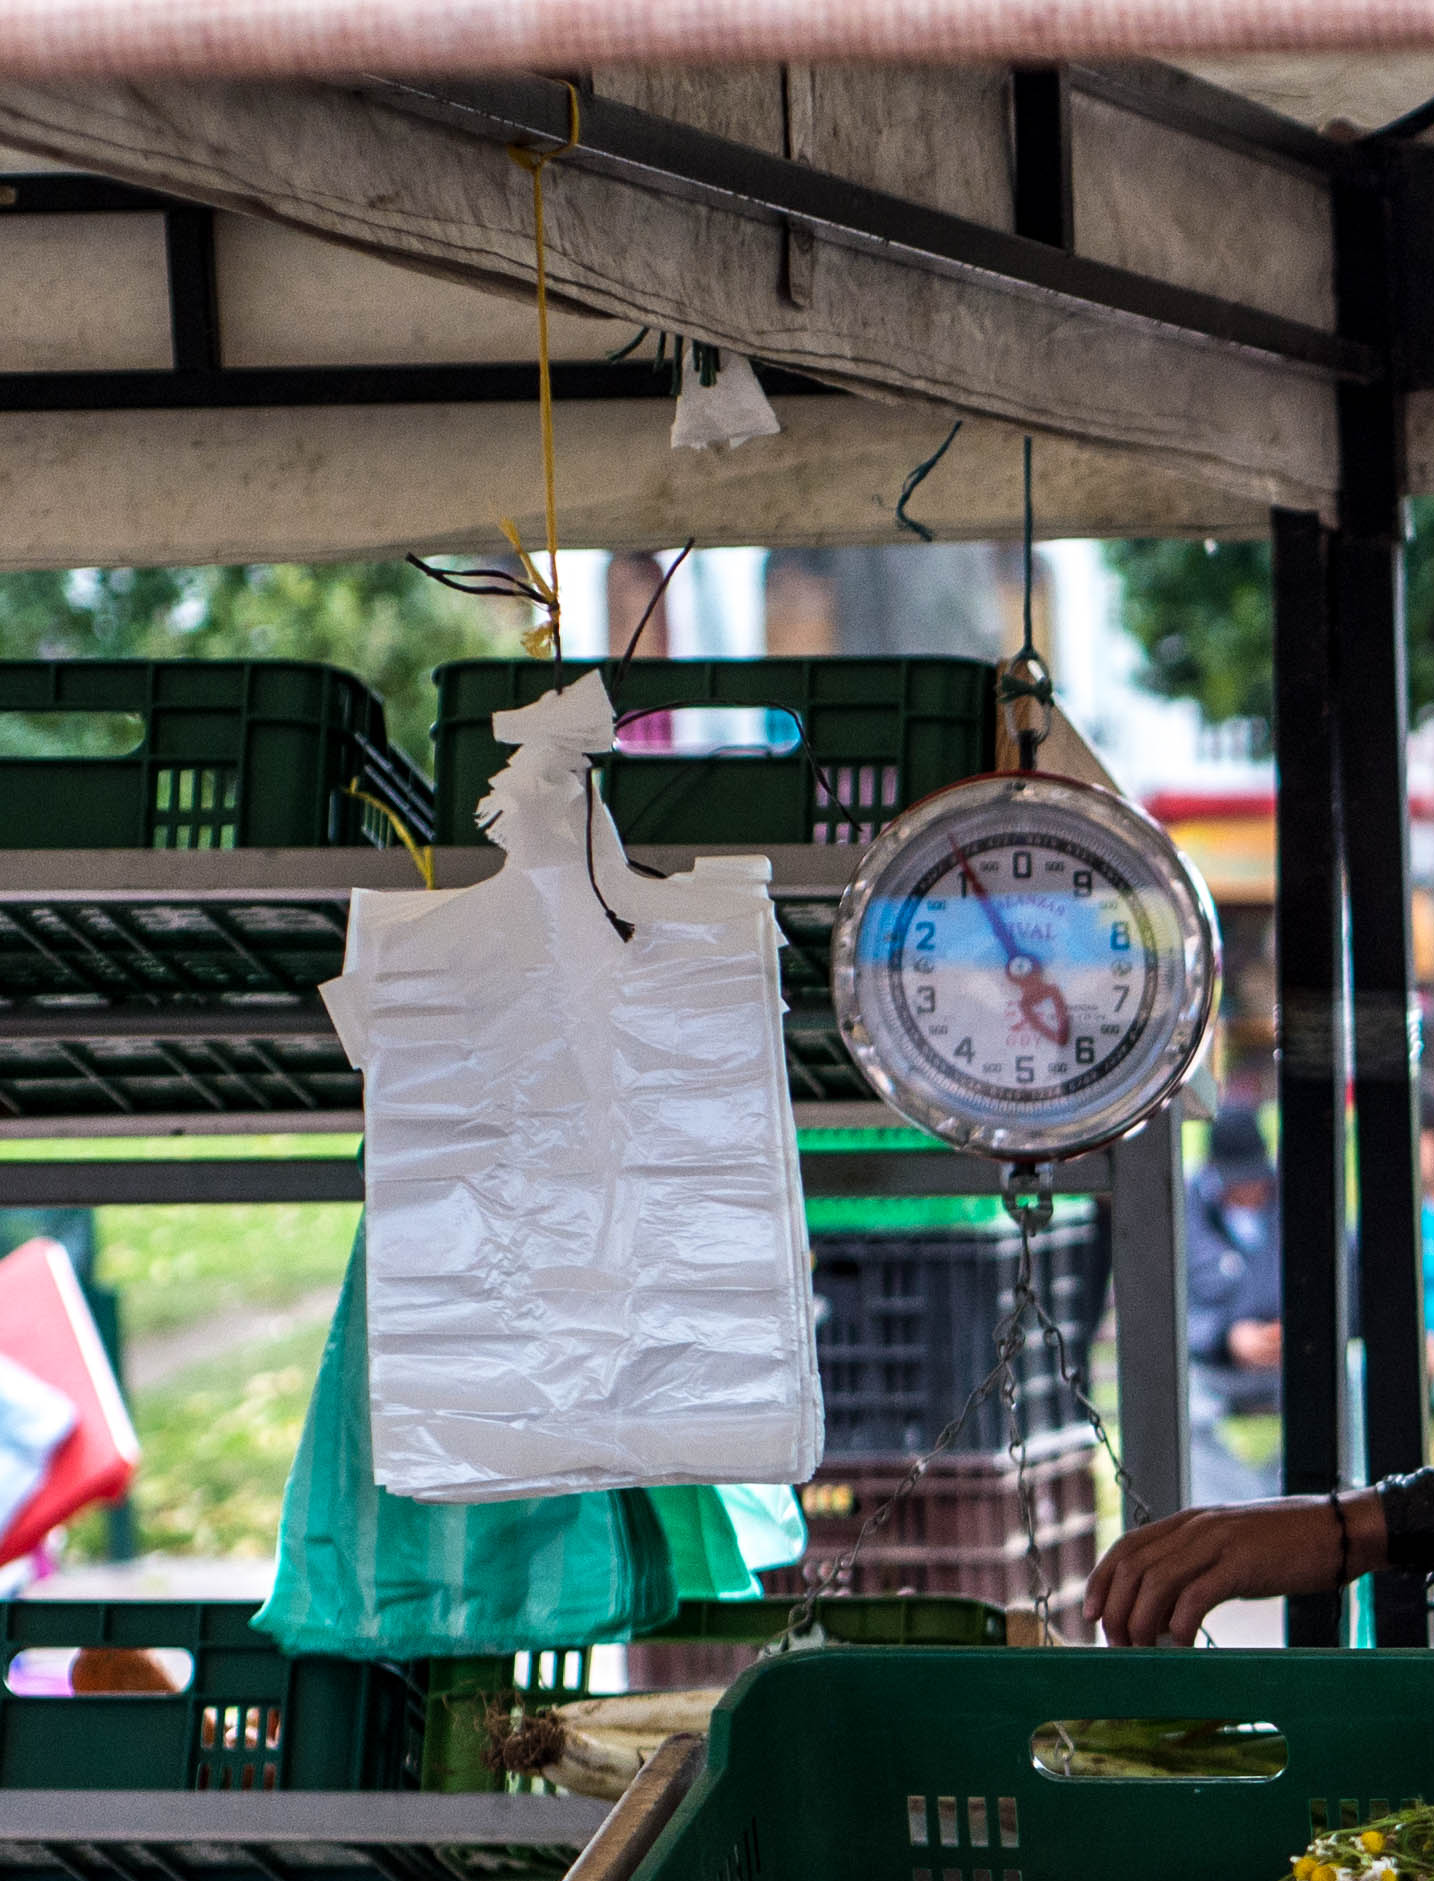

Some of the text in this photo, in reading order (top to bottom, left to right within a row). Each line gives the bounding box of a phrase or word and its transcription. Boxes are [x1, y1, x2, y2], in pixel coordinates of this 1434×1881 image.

[1012, 851, 1033, 879] 0
[1073, 870, 1093, 898] 9
[915, 921, 936, 951] 2
[1110, 921, 1131, 951] 8
[916, 985, 936, 1016] 3
[1112, 985, 1130, 1014] 7
[953, 1036, 976, 1065] 4
[1075, 1036, 1095, 1065] 6
[1015, 1055, 1035, 1084] 5
